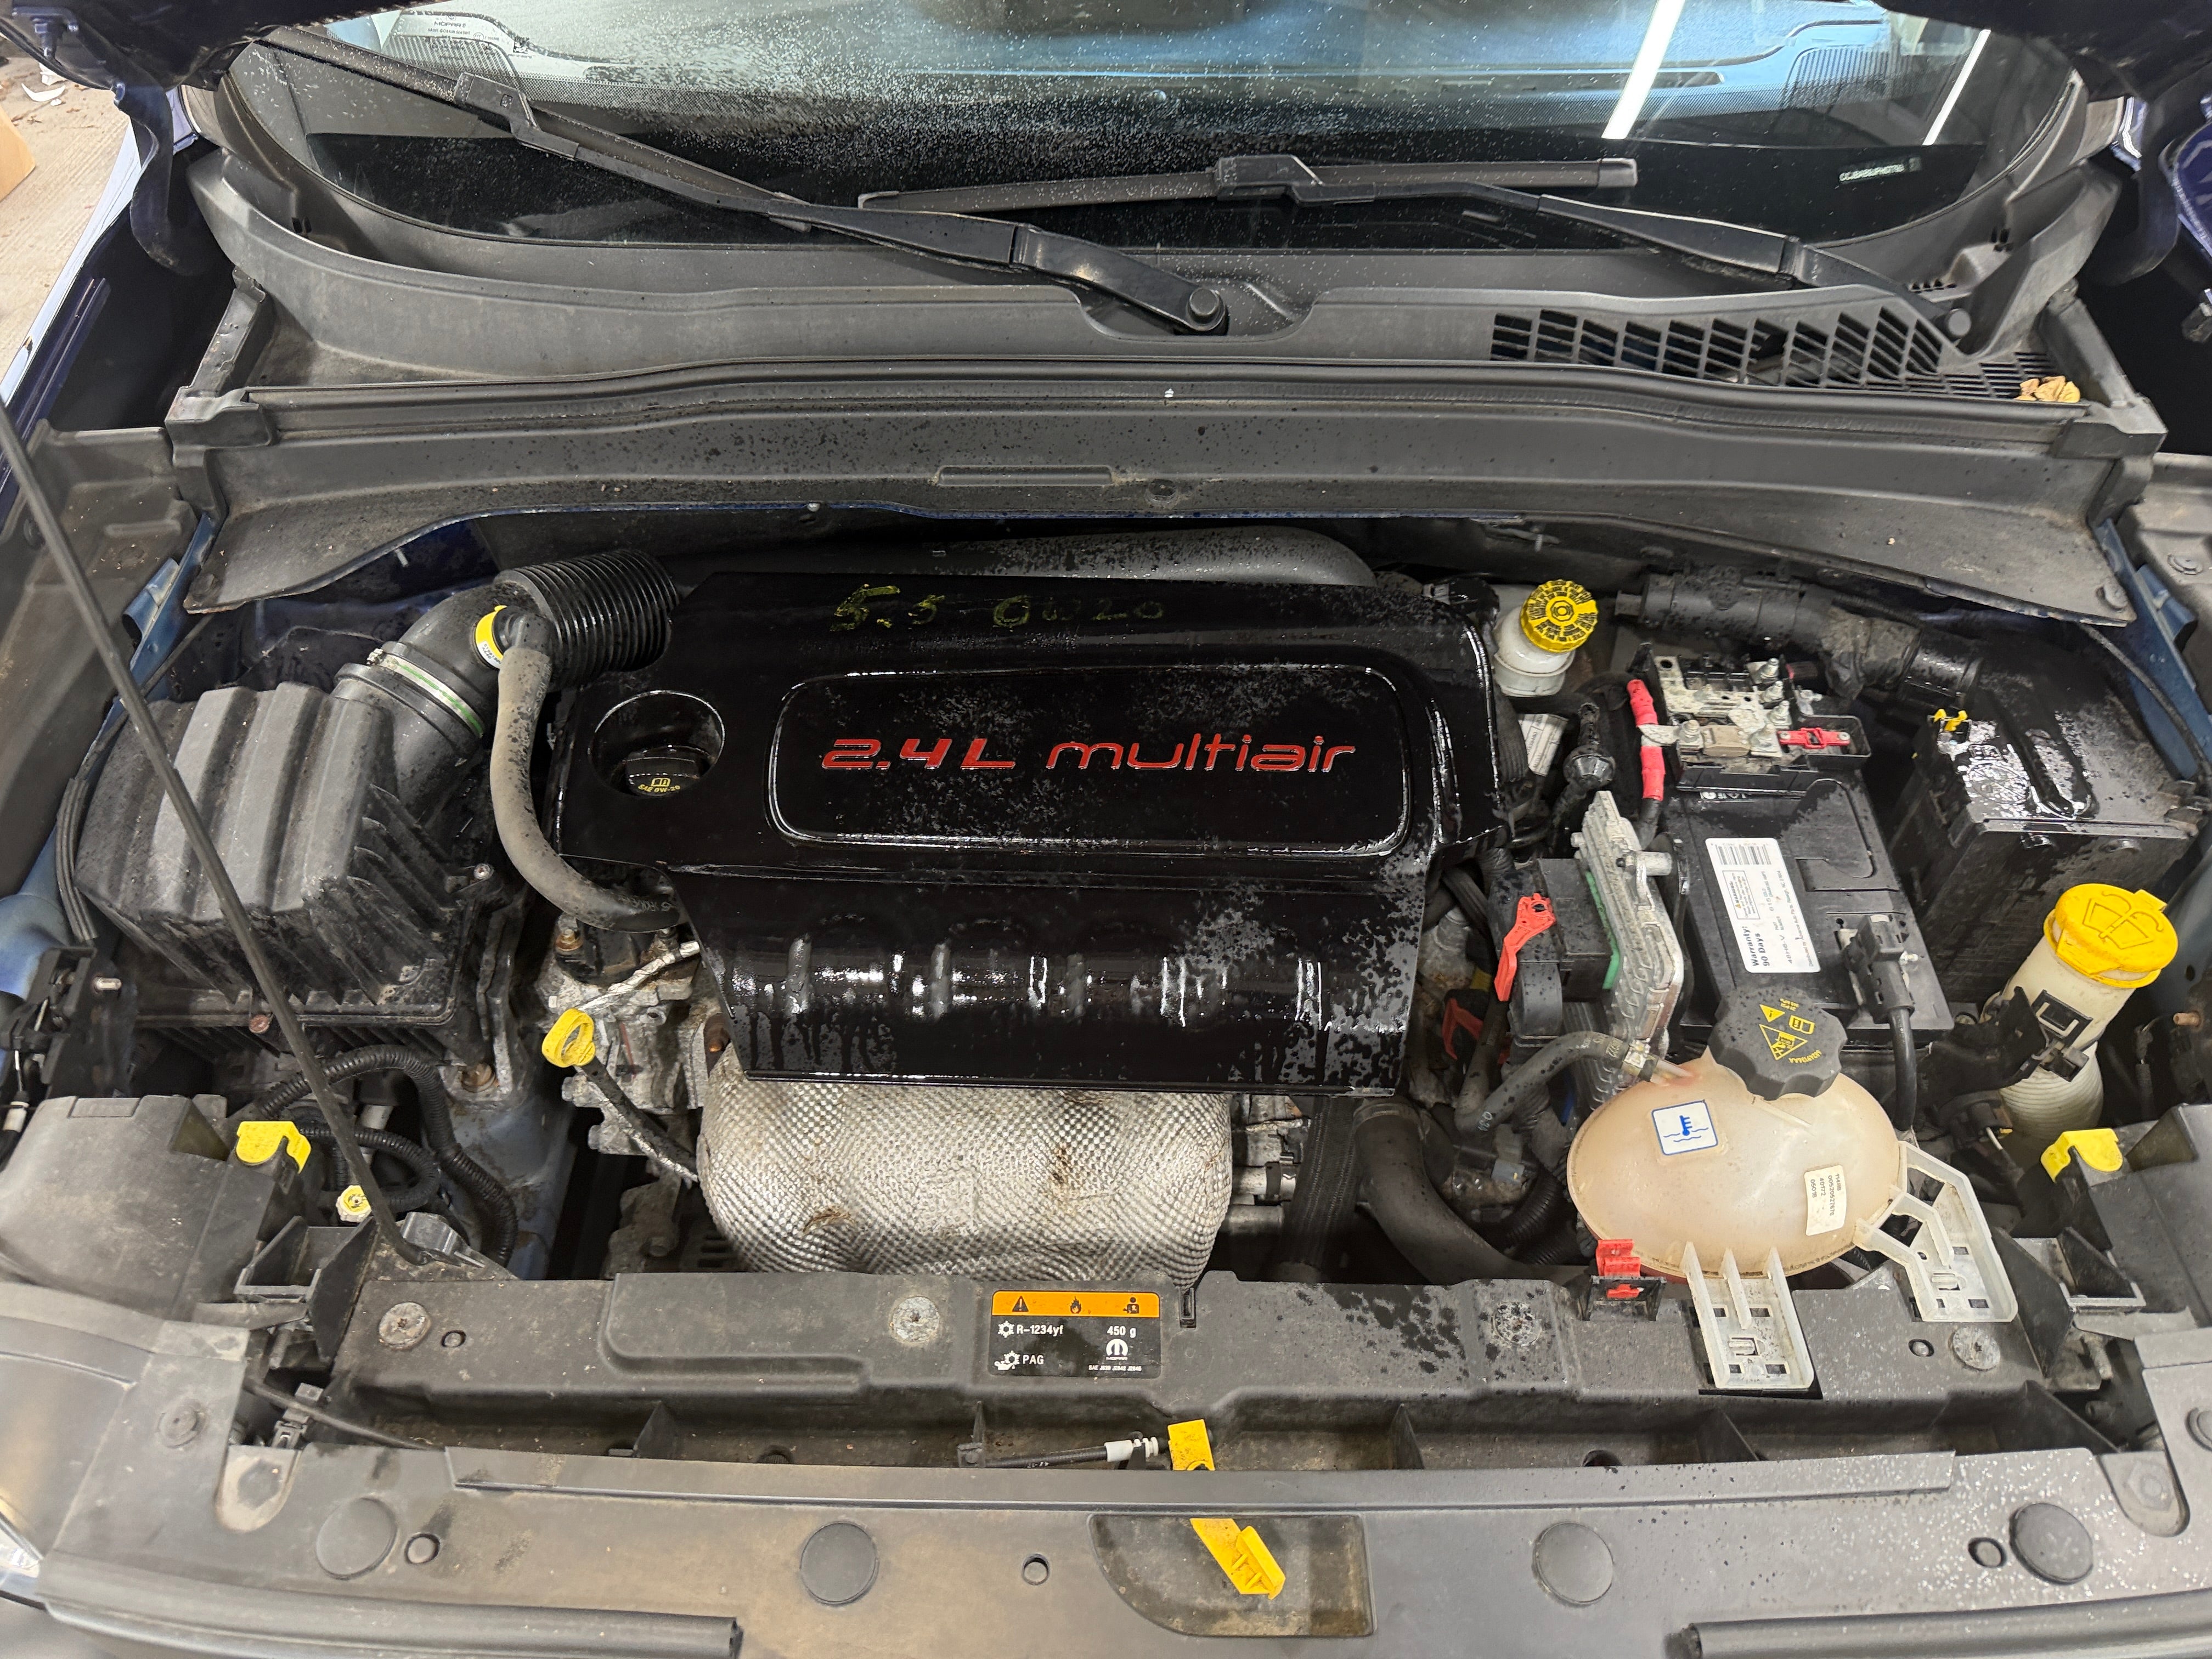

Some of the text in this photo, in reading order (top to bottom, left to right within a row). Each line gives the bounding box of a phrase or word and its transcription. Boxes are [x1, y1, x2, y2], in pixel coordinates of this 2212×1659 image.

[1046, 733, 1356, 772] multiair
[638, 784, 653, 792] SAE
[1742, 926, 1759, 966] Warranty:
[1755, 933, 1770, 966] 90 Days
[1017, 1324, 1136, 1338] R-1234yf 450 g
[1023, 1355, 1044, 1365] PAG
